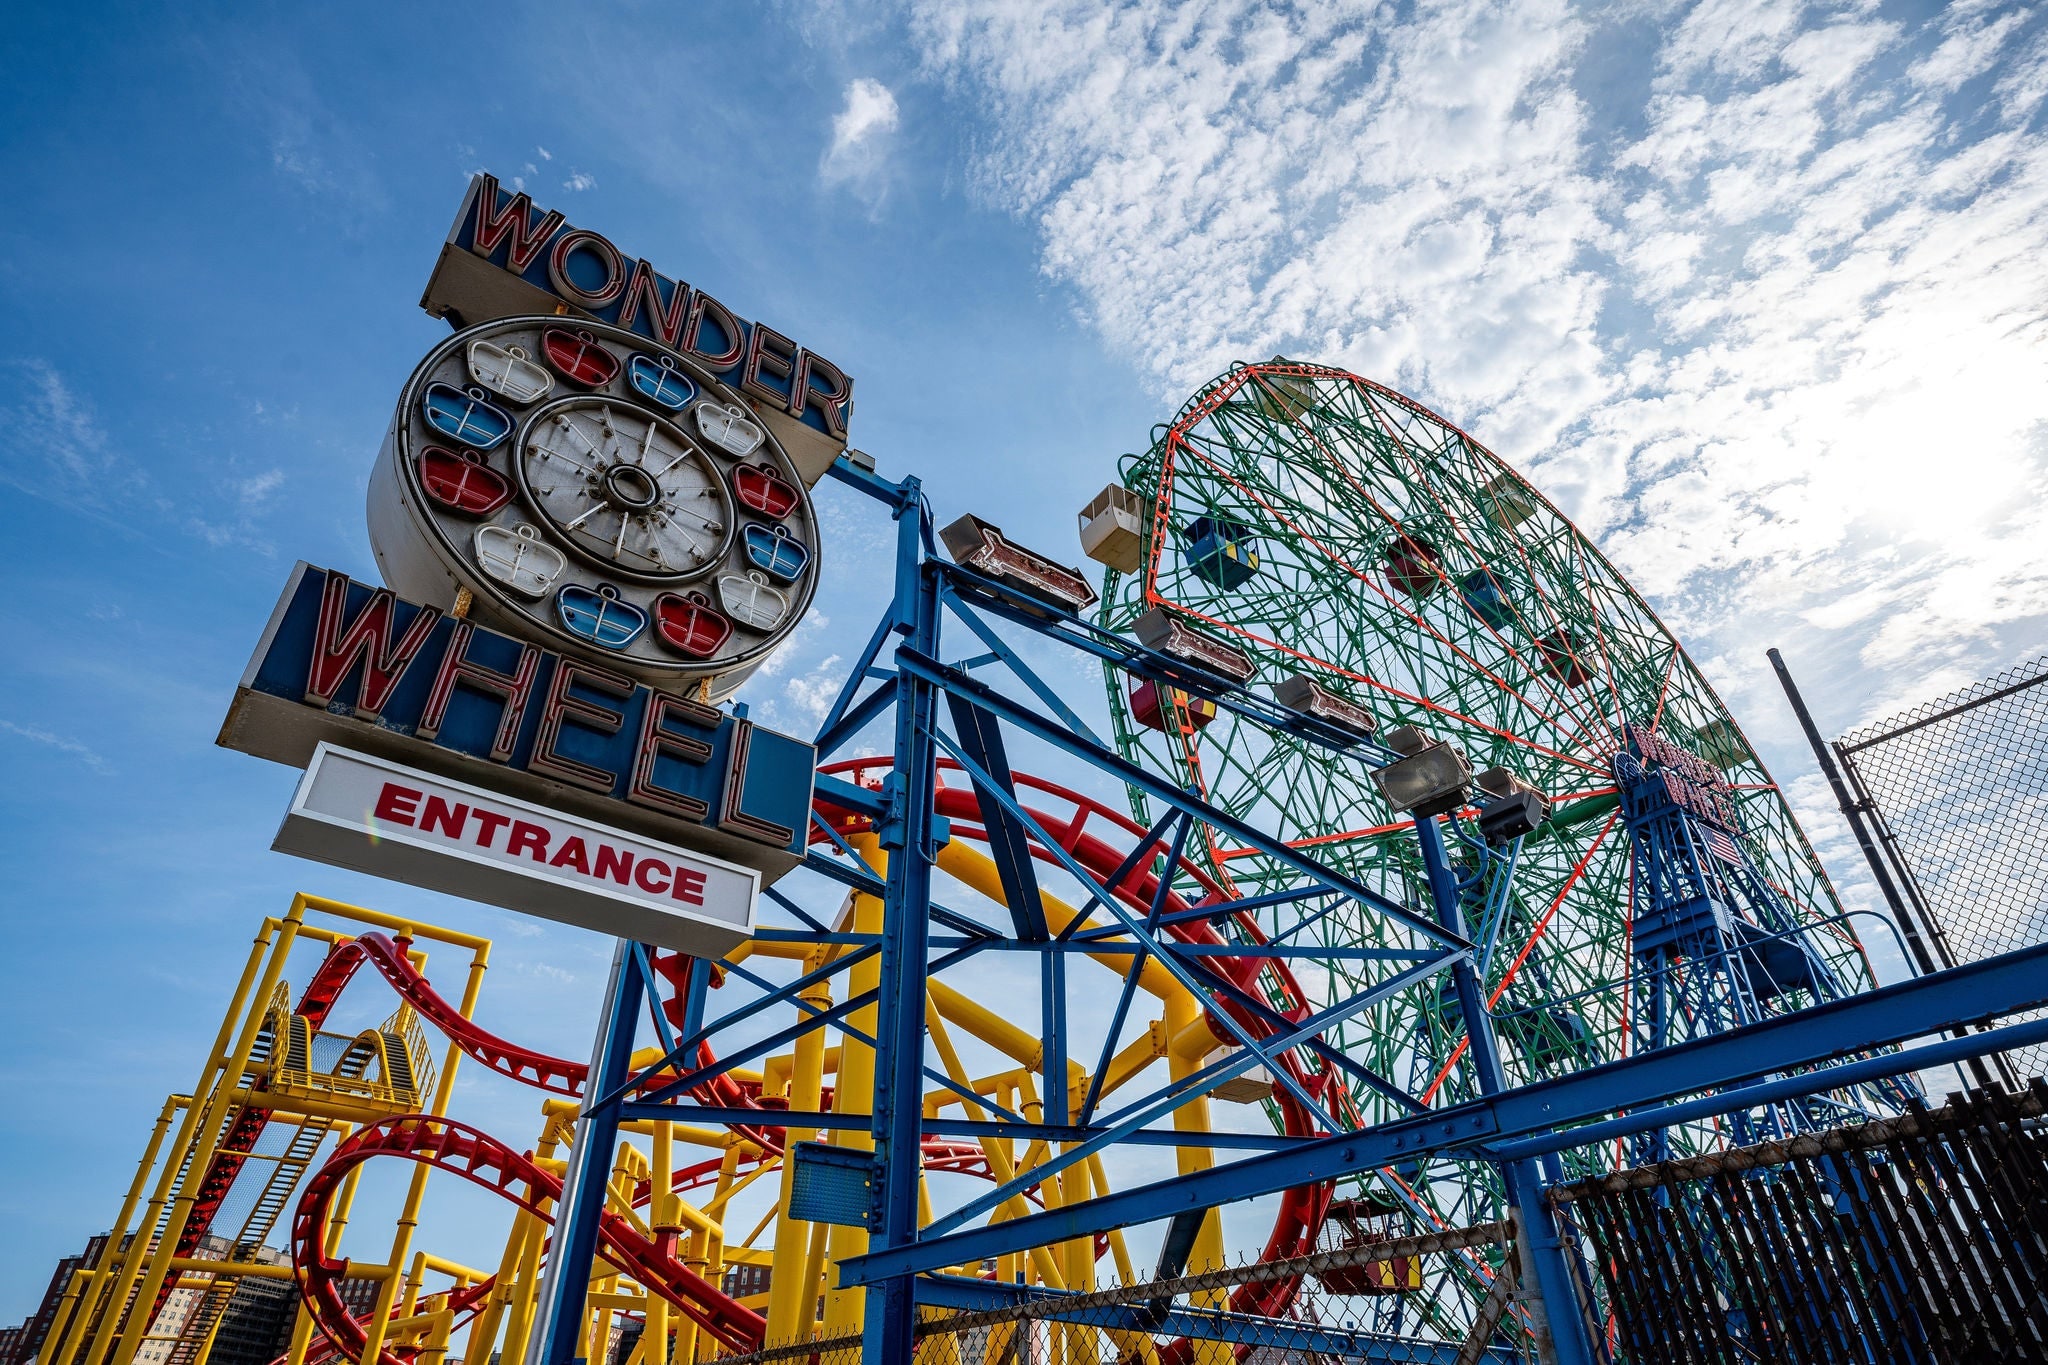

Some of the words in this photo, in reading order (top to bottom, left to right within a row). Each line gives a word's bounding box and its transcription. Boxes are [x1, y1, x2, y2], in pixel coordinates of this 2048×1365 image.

[472, 172, 853, 436] WONDER
[304, 569, 795, 847] WHEEL
[374, 781, 708, 906] ENTRANCE
